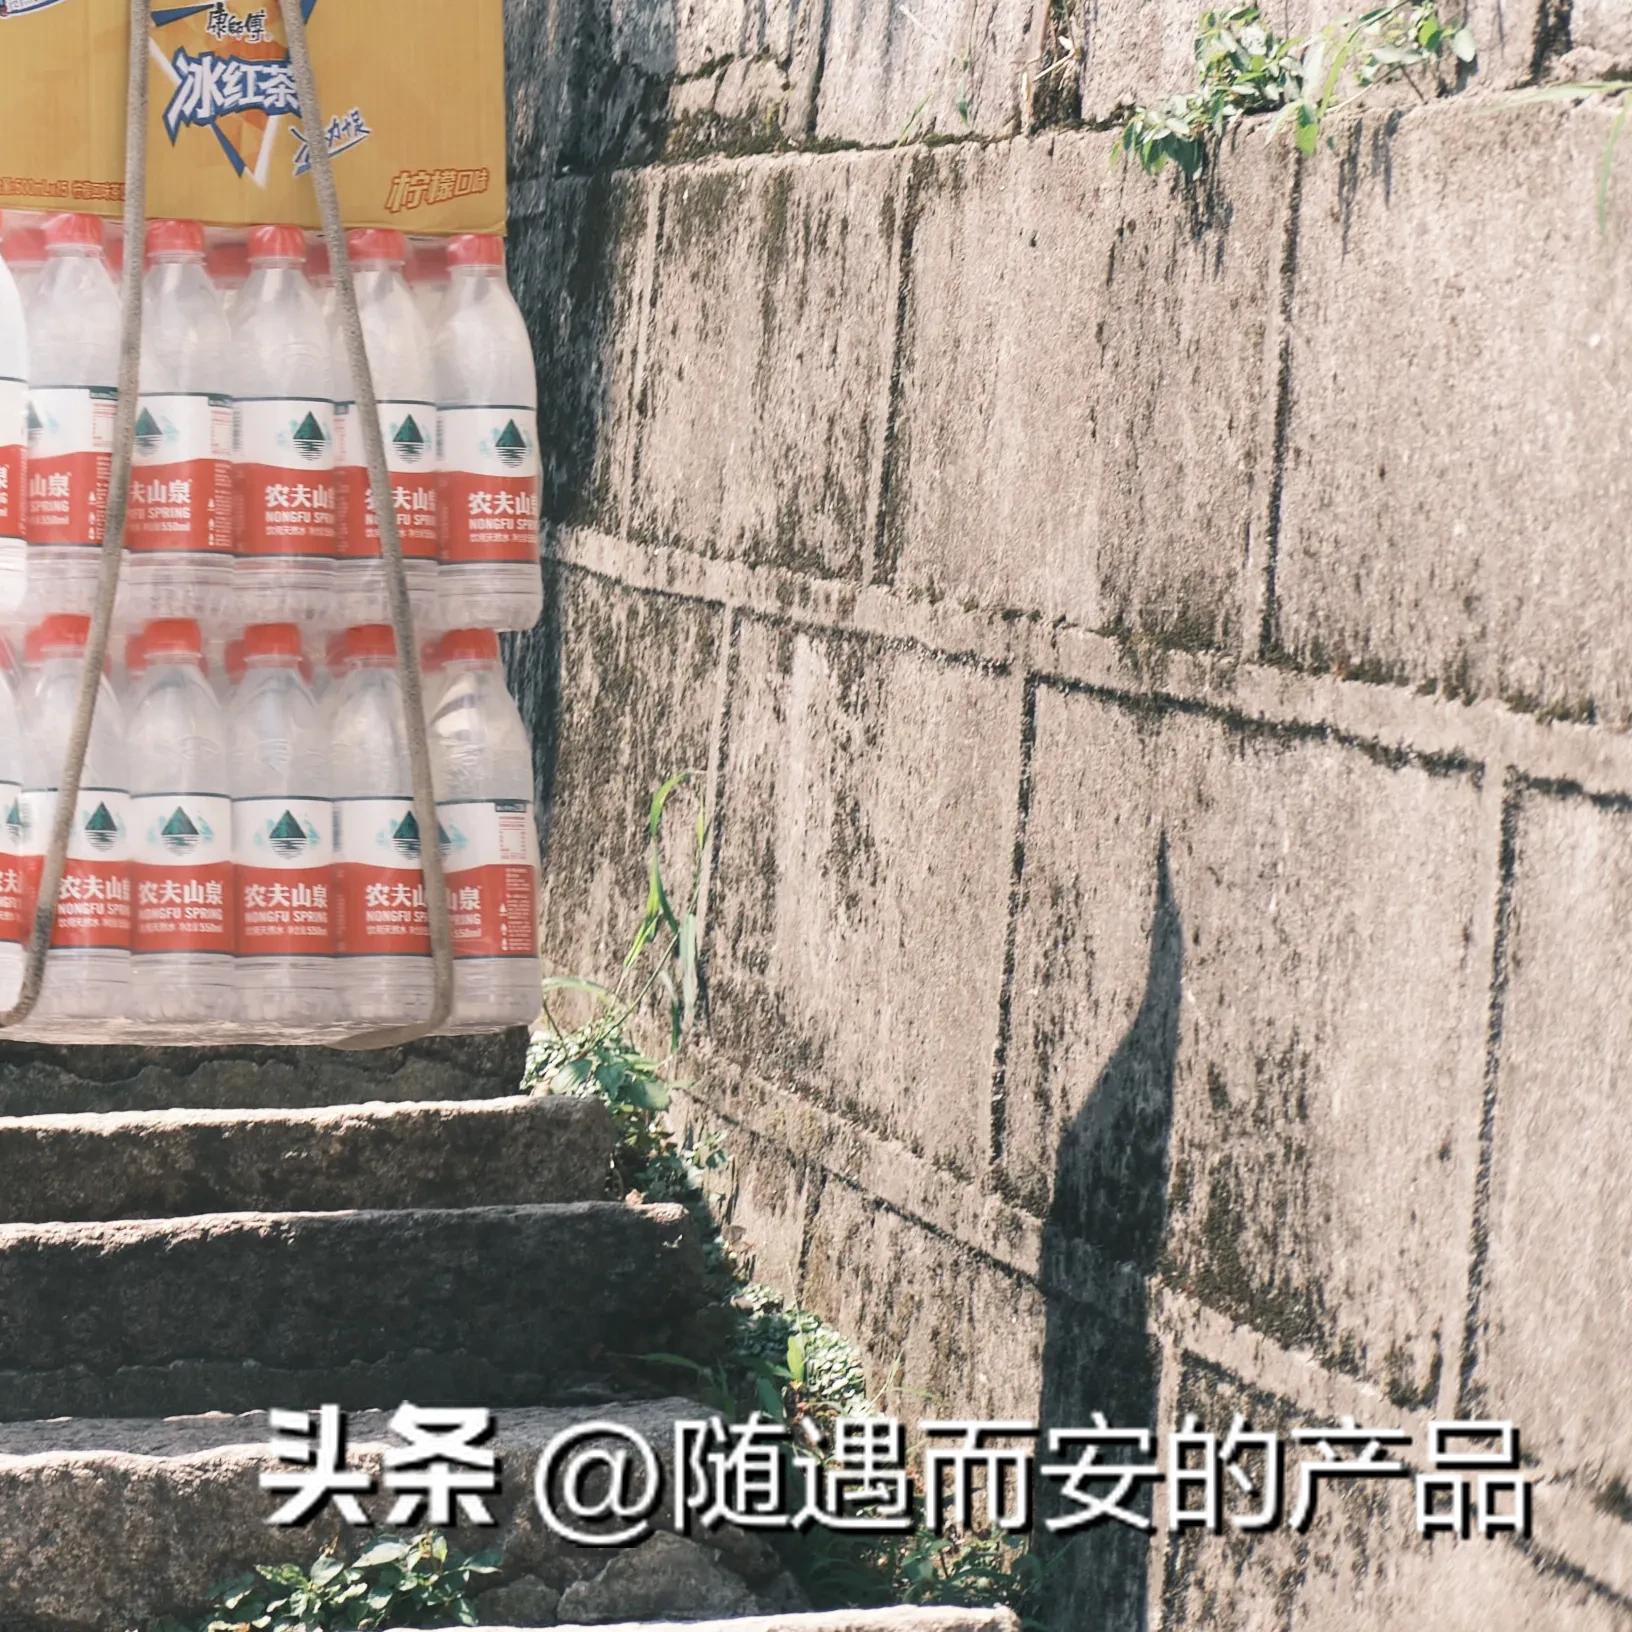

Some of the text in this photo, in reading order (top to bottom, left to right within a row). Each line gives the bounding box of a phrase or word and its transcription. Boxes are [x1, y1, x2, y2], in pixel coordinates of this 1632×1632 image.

[167, 51, 299, 130] 冰红茶
[384, 167, 489, 213] 柠檬口味
[148, 507, 191, 519] SPRING
[265, 511, 311, 524] NONGFU
[468, 518, 514, 530] NONGFU
[139, 880, 223, 905] 农夫山泉
[244, 882, 328, 908] 农夫山泉
[58, 903, 105, 916] NONGFU
[185, 908, 223, 921] SPRING
[244, 911, 290, 923] NONGFU
[365, 911, 412, 923] NONGFU
